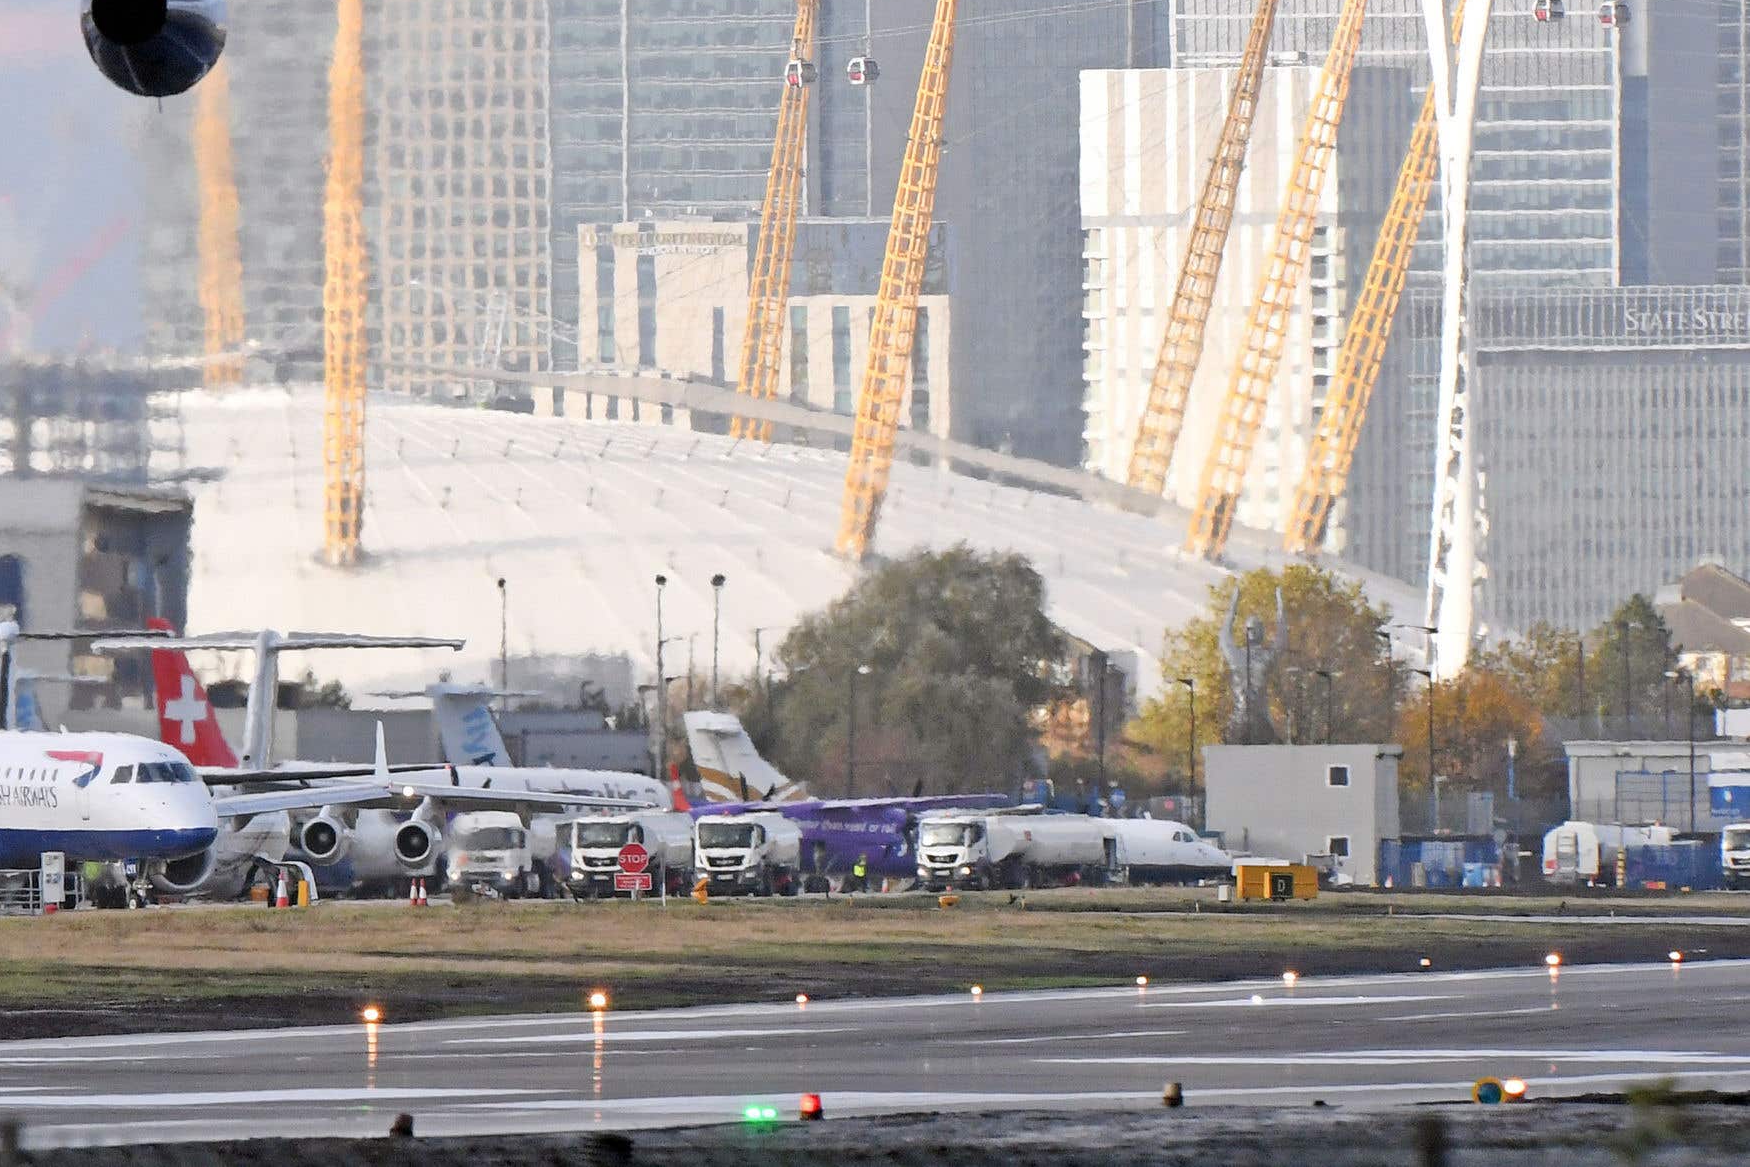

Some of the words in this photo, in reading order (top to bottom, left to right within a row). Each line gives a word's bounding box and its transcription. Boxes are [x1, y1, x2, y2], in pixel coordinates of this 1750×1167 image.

[1624, 308, 1690, 332] STATE
[1692, 306, 1749, 332] STRE
[619, 854, 647, 864] STOP
[1277, 879, 1287, 892] D
